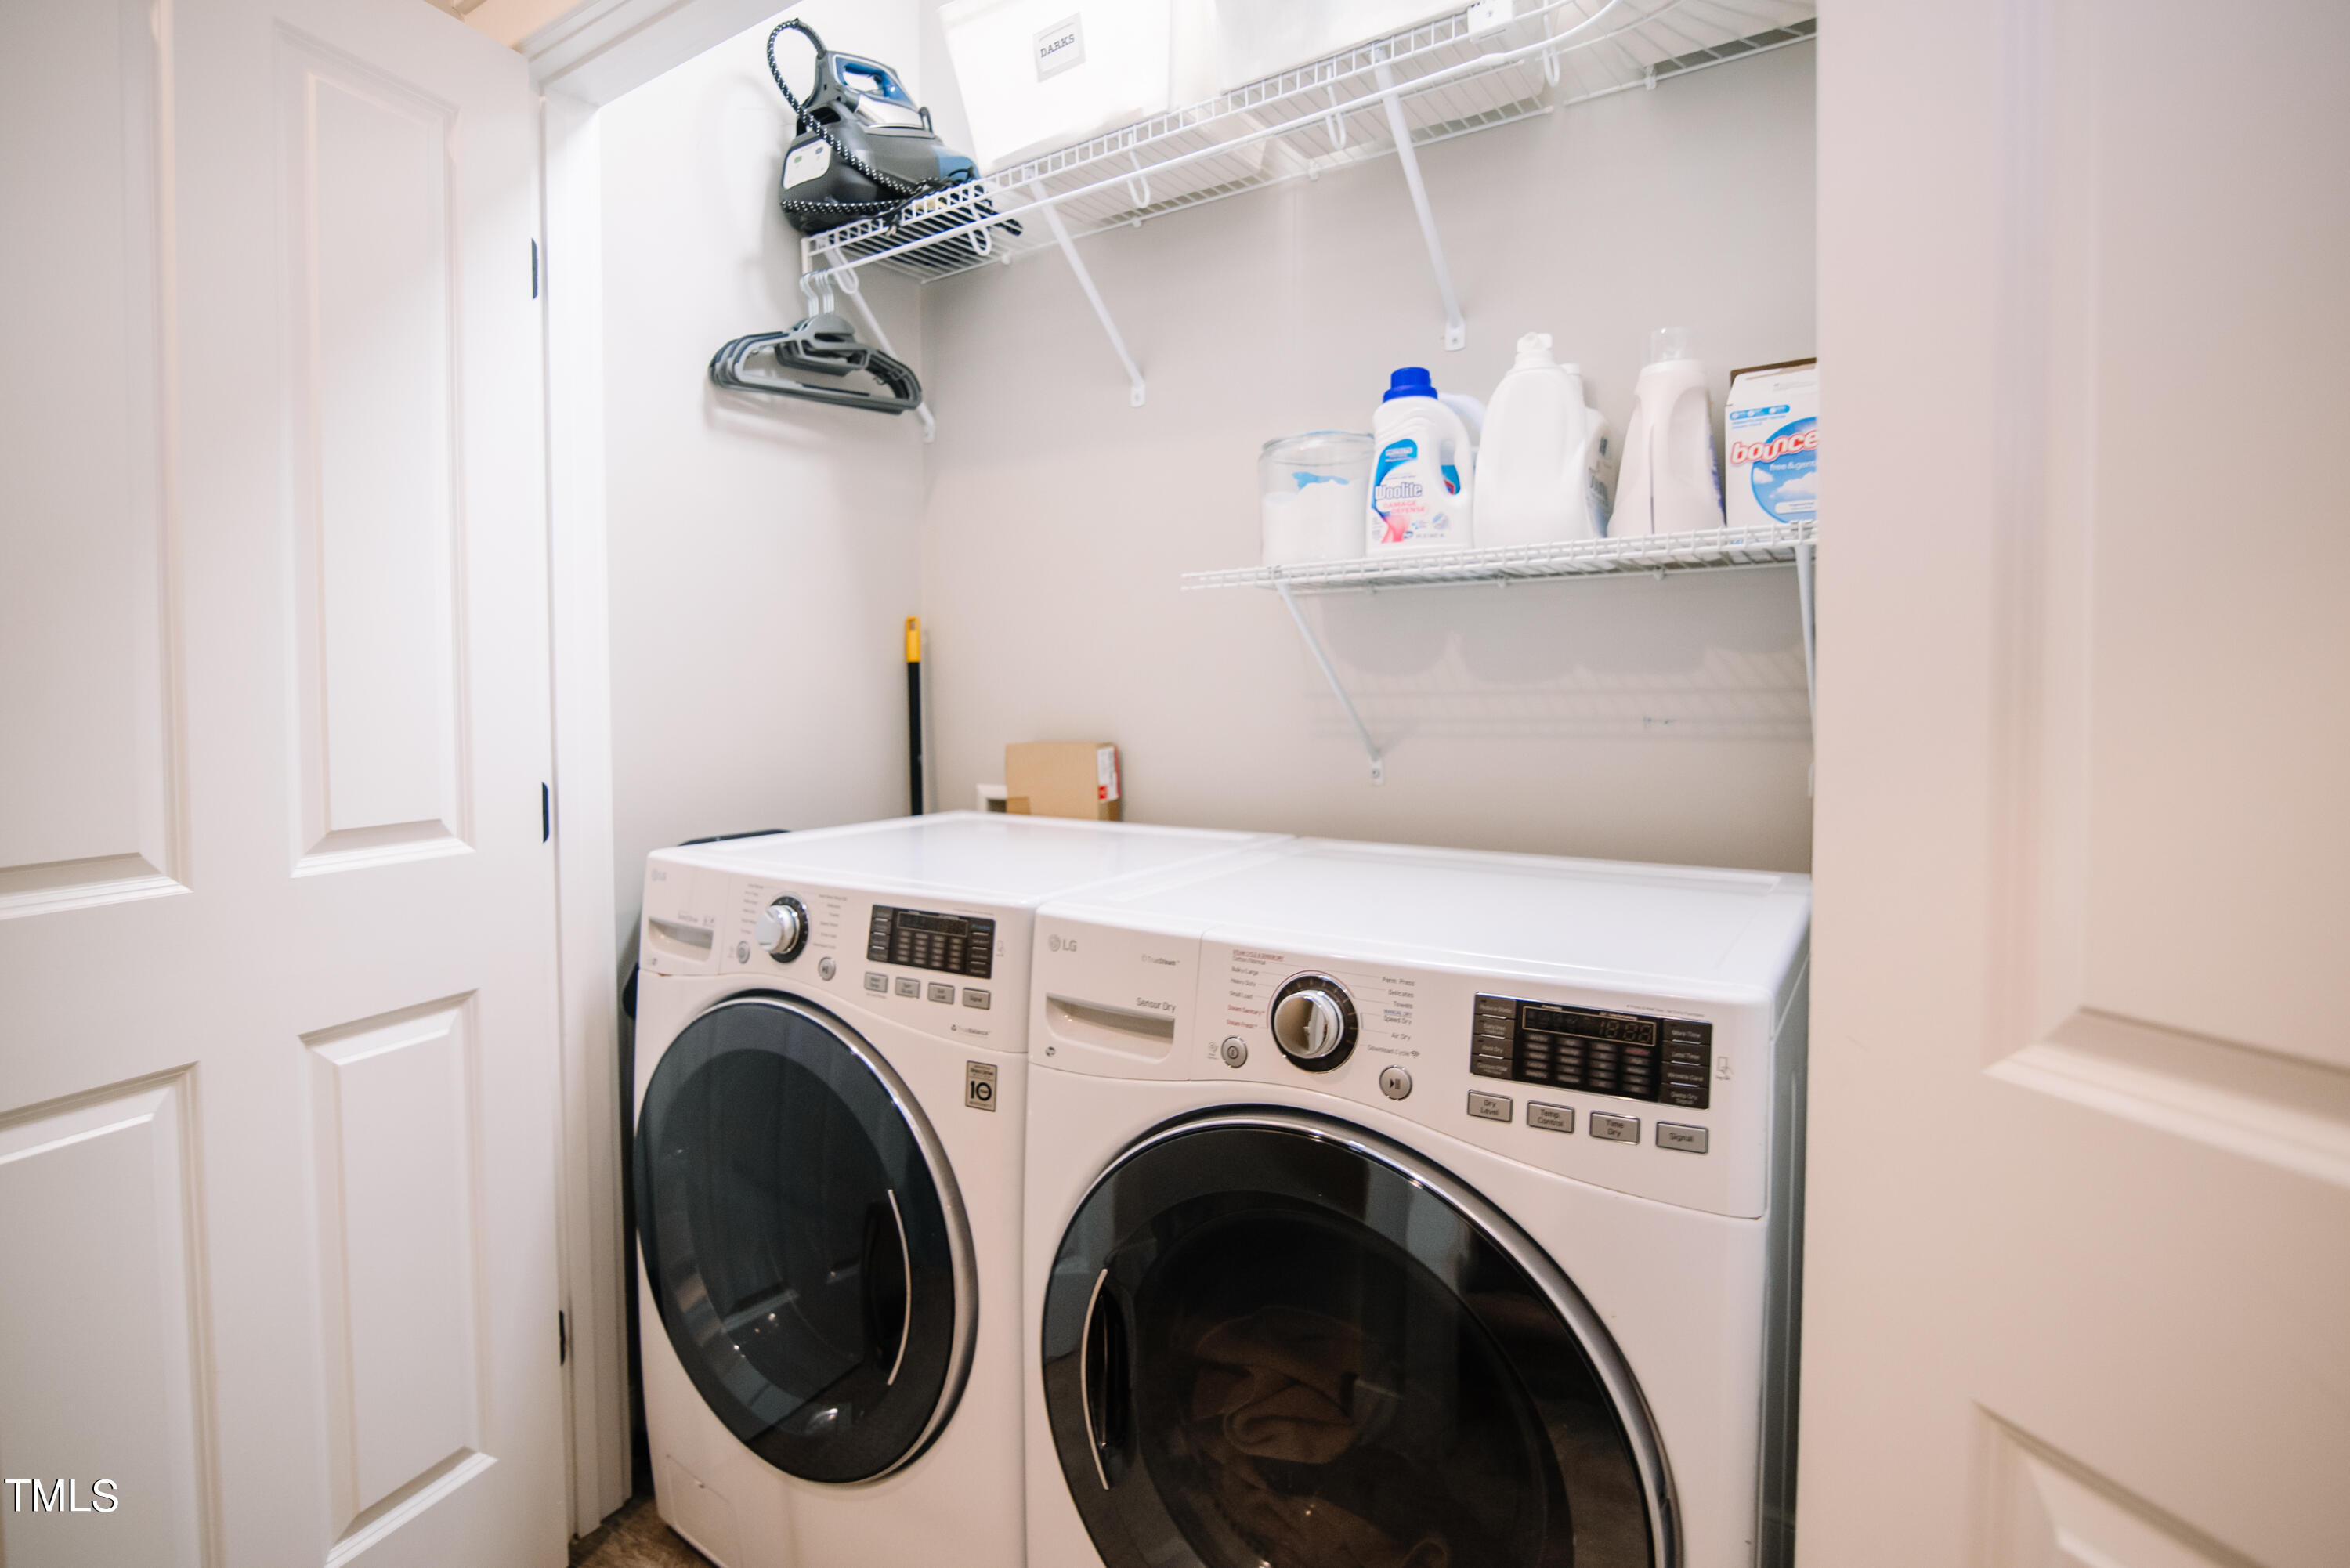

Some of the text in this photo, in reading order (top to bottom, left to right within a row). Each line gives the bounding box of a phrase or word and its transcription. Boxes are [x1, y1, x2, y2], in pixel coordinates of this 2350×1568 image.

[1040, 34, 1076, 59] DARKS
[1730, 429, 1817, 465] bounce
[1375, 482, 1423, 500] Woolite
[1062, 939, 1077, 952] LG
[1137, 996, 1176, 1013] Sensor Dry
[971, 1081, 992, 1101] 10
[1484, 1098, 1497, 1108] Dry
[1480, 1106, 1499, 1116] Level
[1537, 1117, 1564, 1128] Control
[1606, 1119, 1624, 1129] Time
[1607, 1127, 1622, 1138] Dry
[1668, 1132, 1694, 1143] Signal
